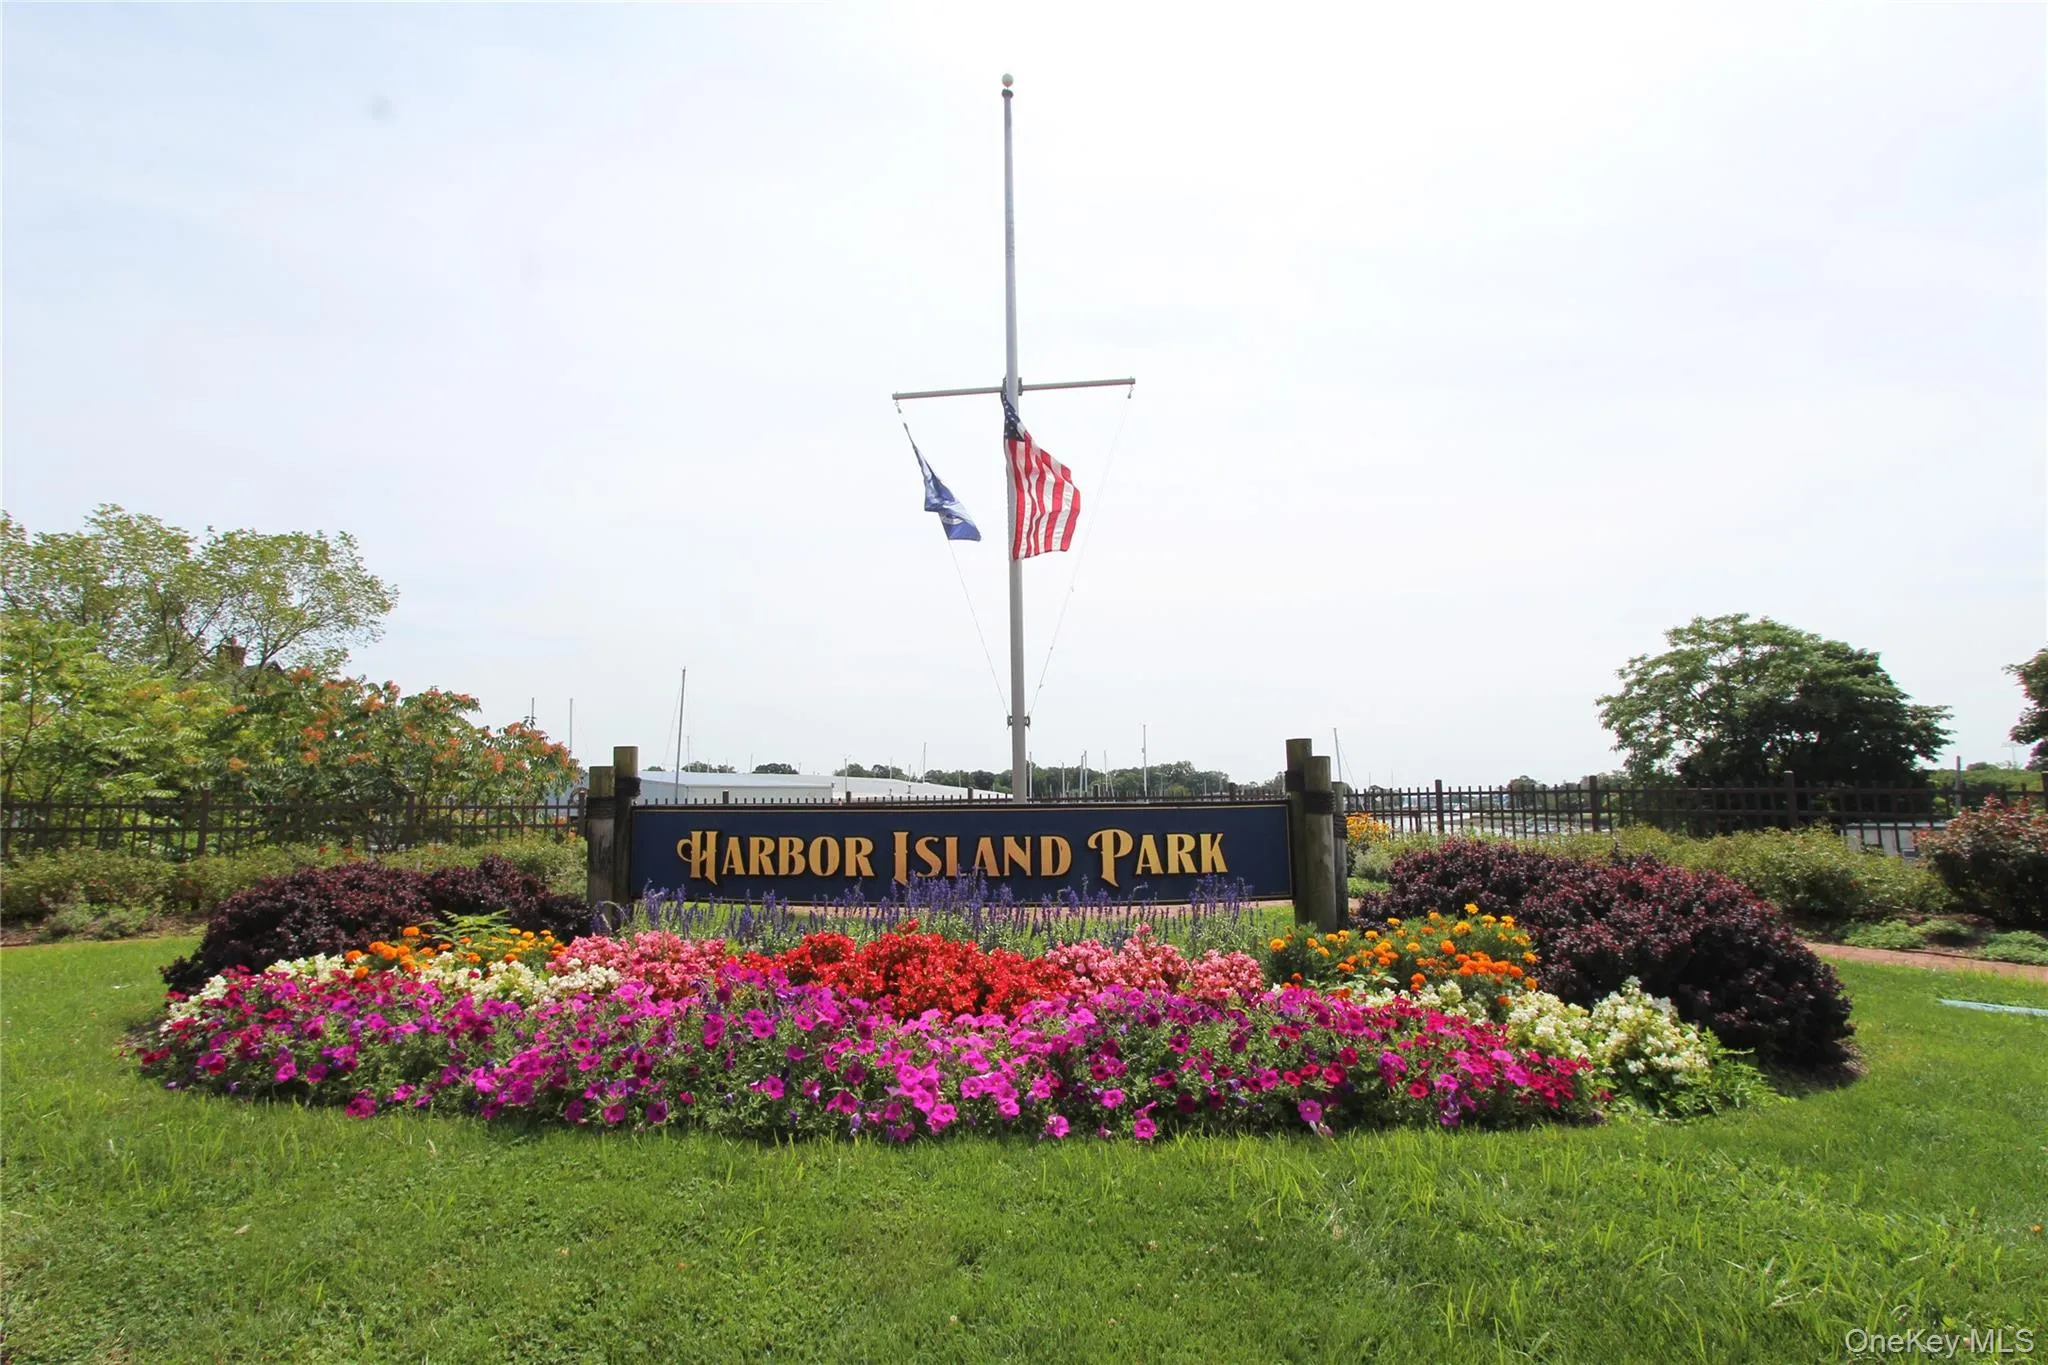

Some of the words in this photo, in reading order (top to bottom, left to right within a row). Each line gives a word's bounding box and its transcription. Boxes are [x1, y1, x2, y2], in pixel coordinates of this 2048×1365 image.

[677, 830, 875, 886] HARBOR
[893, 831, 1072, 886] ISLAND
[1088, 829, 1228, 887] PARK
